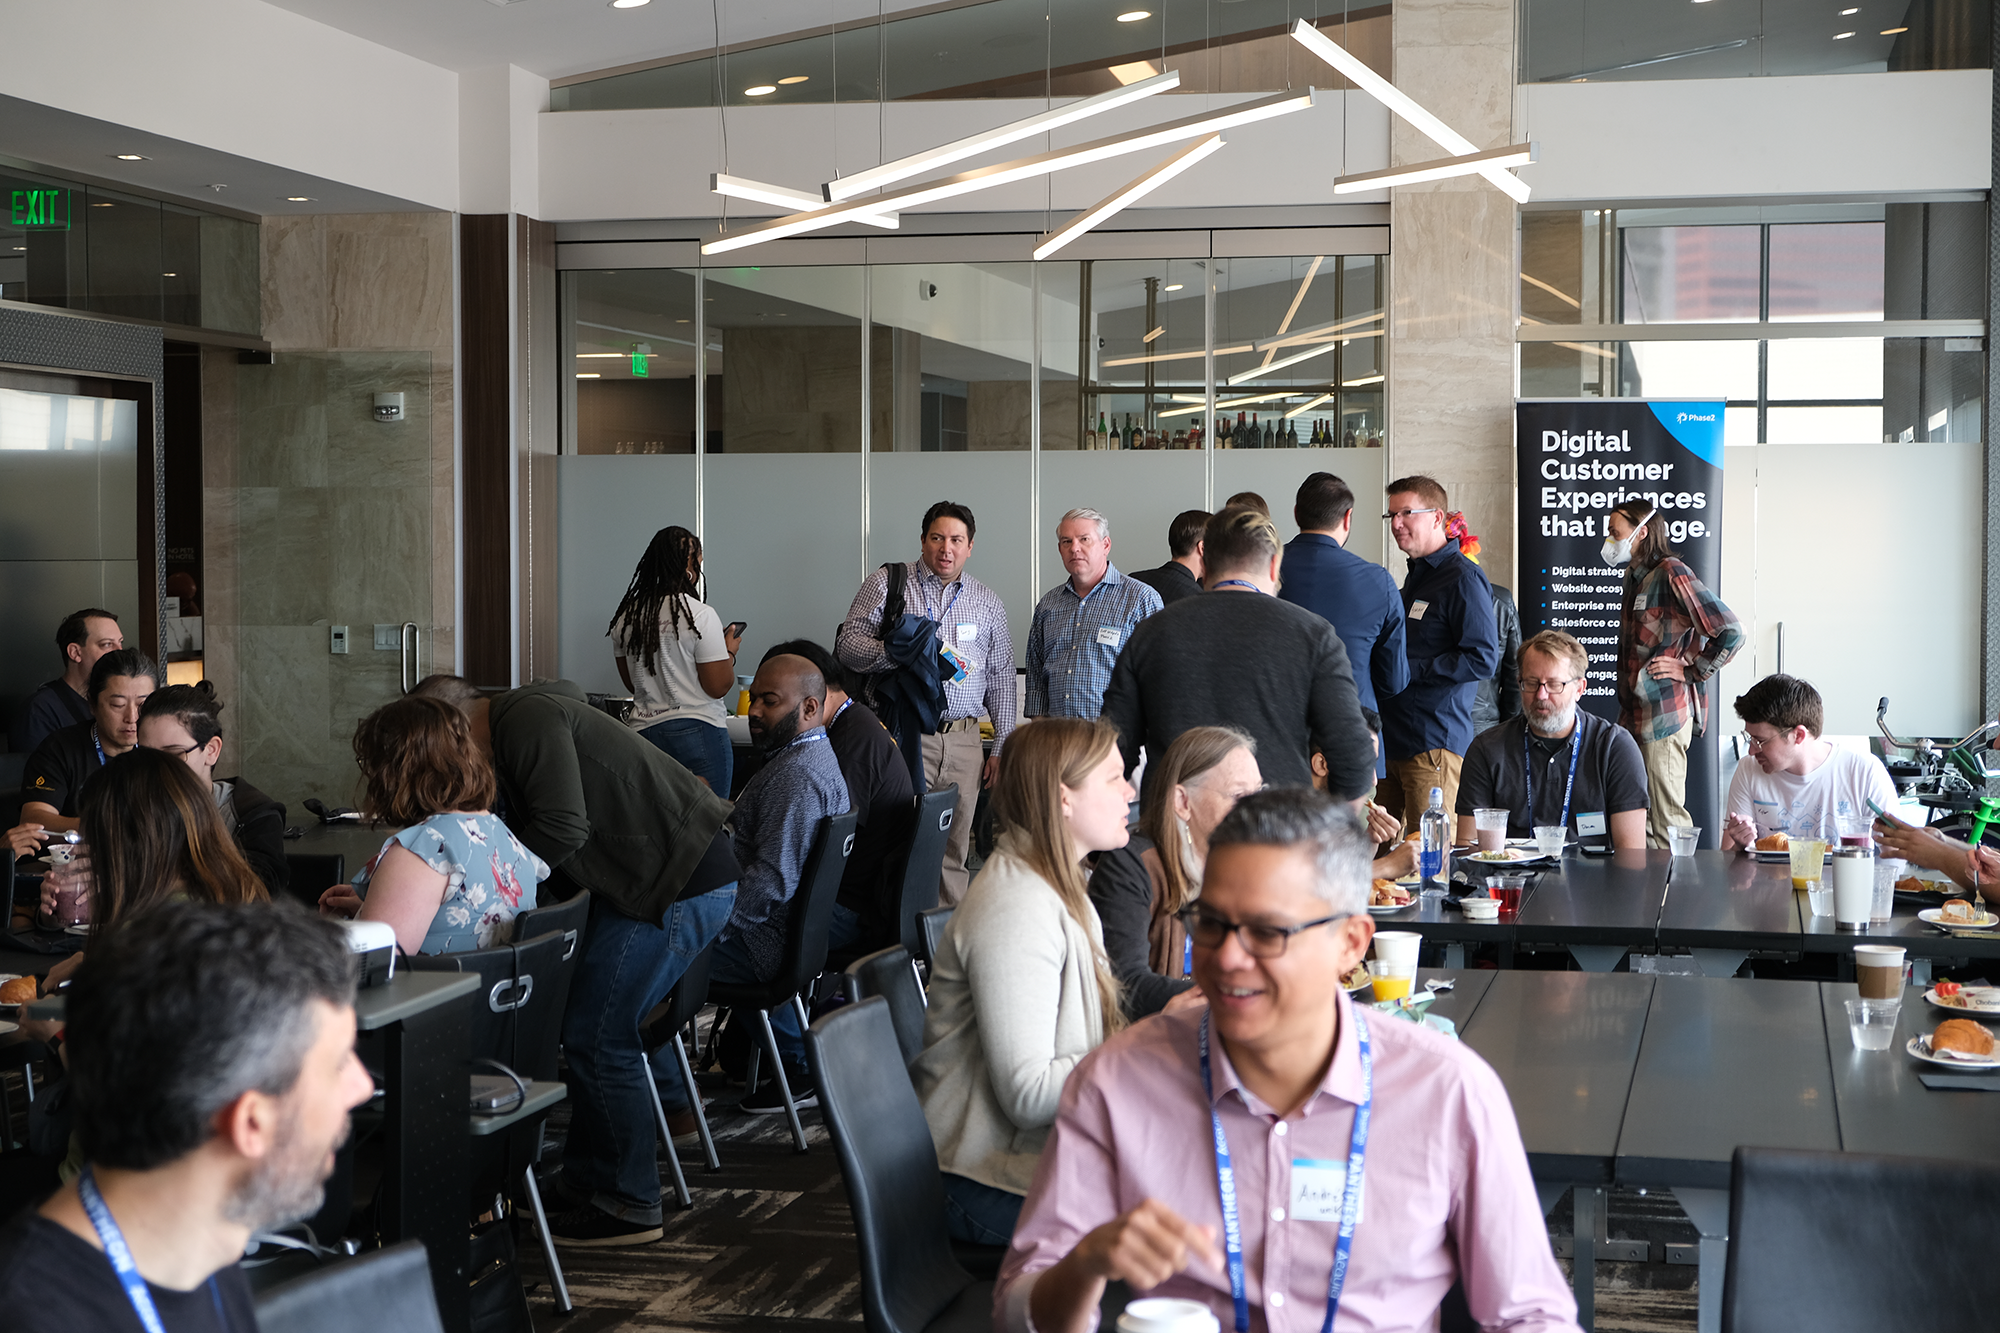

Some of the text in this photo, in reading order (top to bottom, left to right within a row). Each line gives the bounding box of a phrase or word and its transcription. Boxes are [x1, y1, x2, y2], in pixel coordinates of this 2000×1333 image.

[11, 190, 59, 225] EXIT
[1688, 414, 1716, 422] Phase2
[1541, 429, 1631, 458] Digital
[1540, 458, 1674, 481] Customer
[1540, 514, 1596, 537] that
[1551, 566, 1627, 579] Digital strateg
[1551, 583, 1595, 593] Website
[1551, 600, 1605, 612] Enterprise
[1551, 617, 1606, 628] Salesforce
[1563, 774, 1574, 807] PANTHEON
[1338, 1152, 1365, 1238] PANTHEON
[1218, 1167, 1242, 1254] PANTHEON
